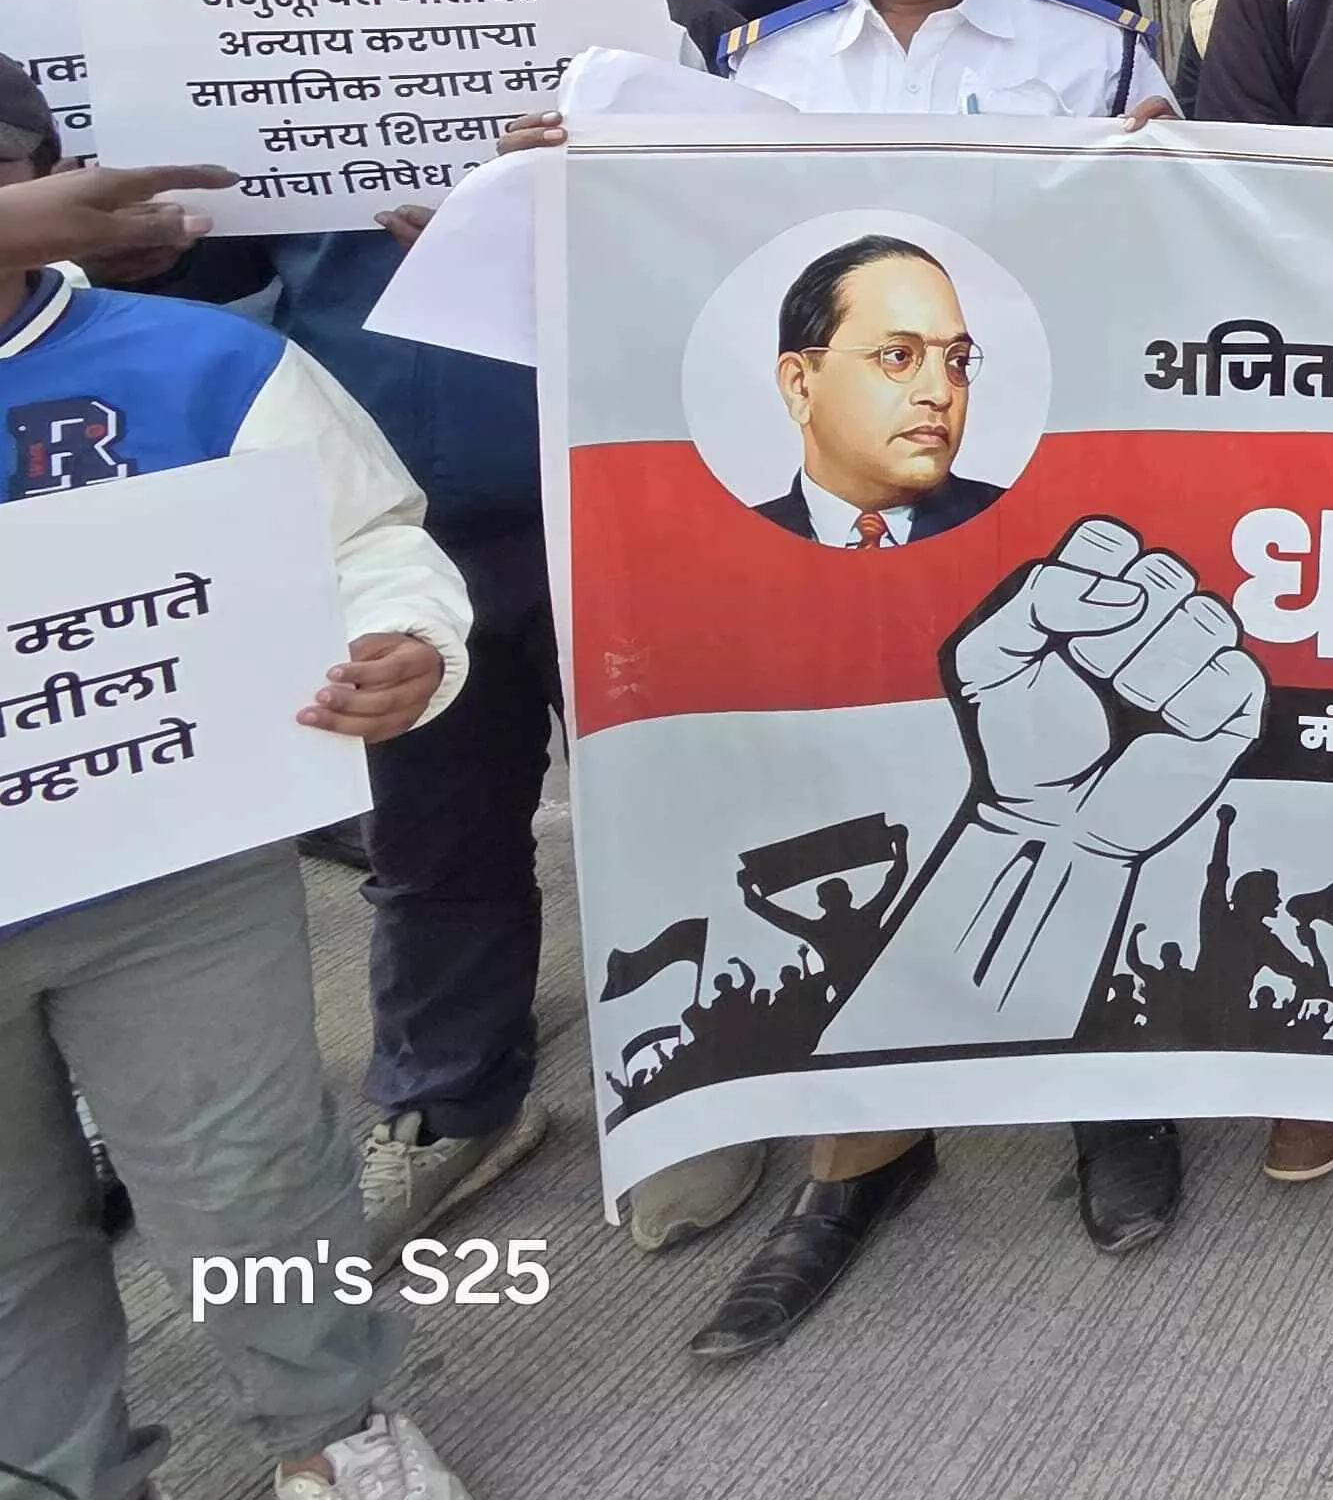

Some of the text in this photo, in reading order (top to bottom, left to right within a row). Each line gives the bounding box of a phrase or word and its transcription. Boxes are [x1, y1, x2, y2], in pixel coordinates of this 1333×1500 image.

[218, 22, 536, 58] अन्याय करणाऱ्या
[186, 68, 381, 108] सामाजिक
[389, 71, 492, 98] न्याय
[259, 112, 527, 154] संजय शिरसा
[240, 158, 452, 200] यांचा निषेध
[8, 572, 212, 654] म्हणते
[0, 657, 180, 738] तीला
